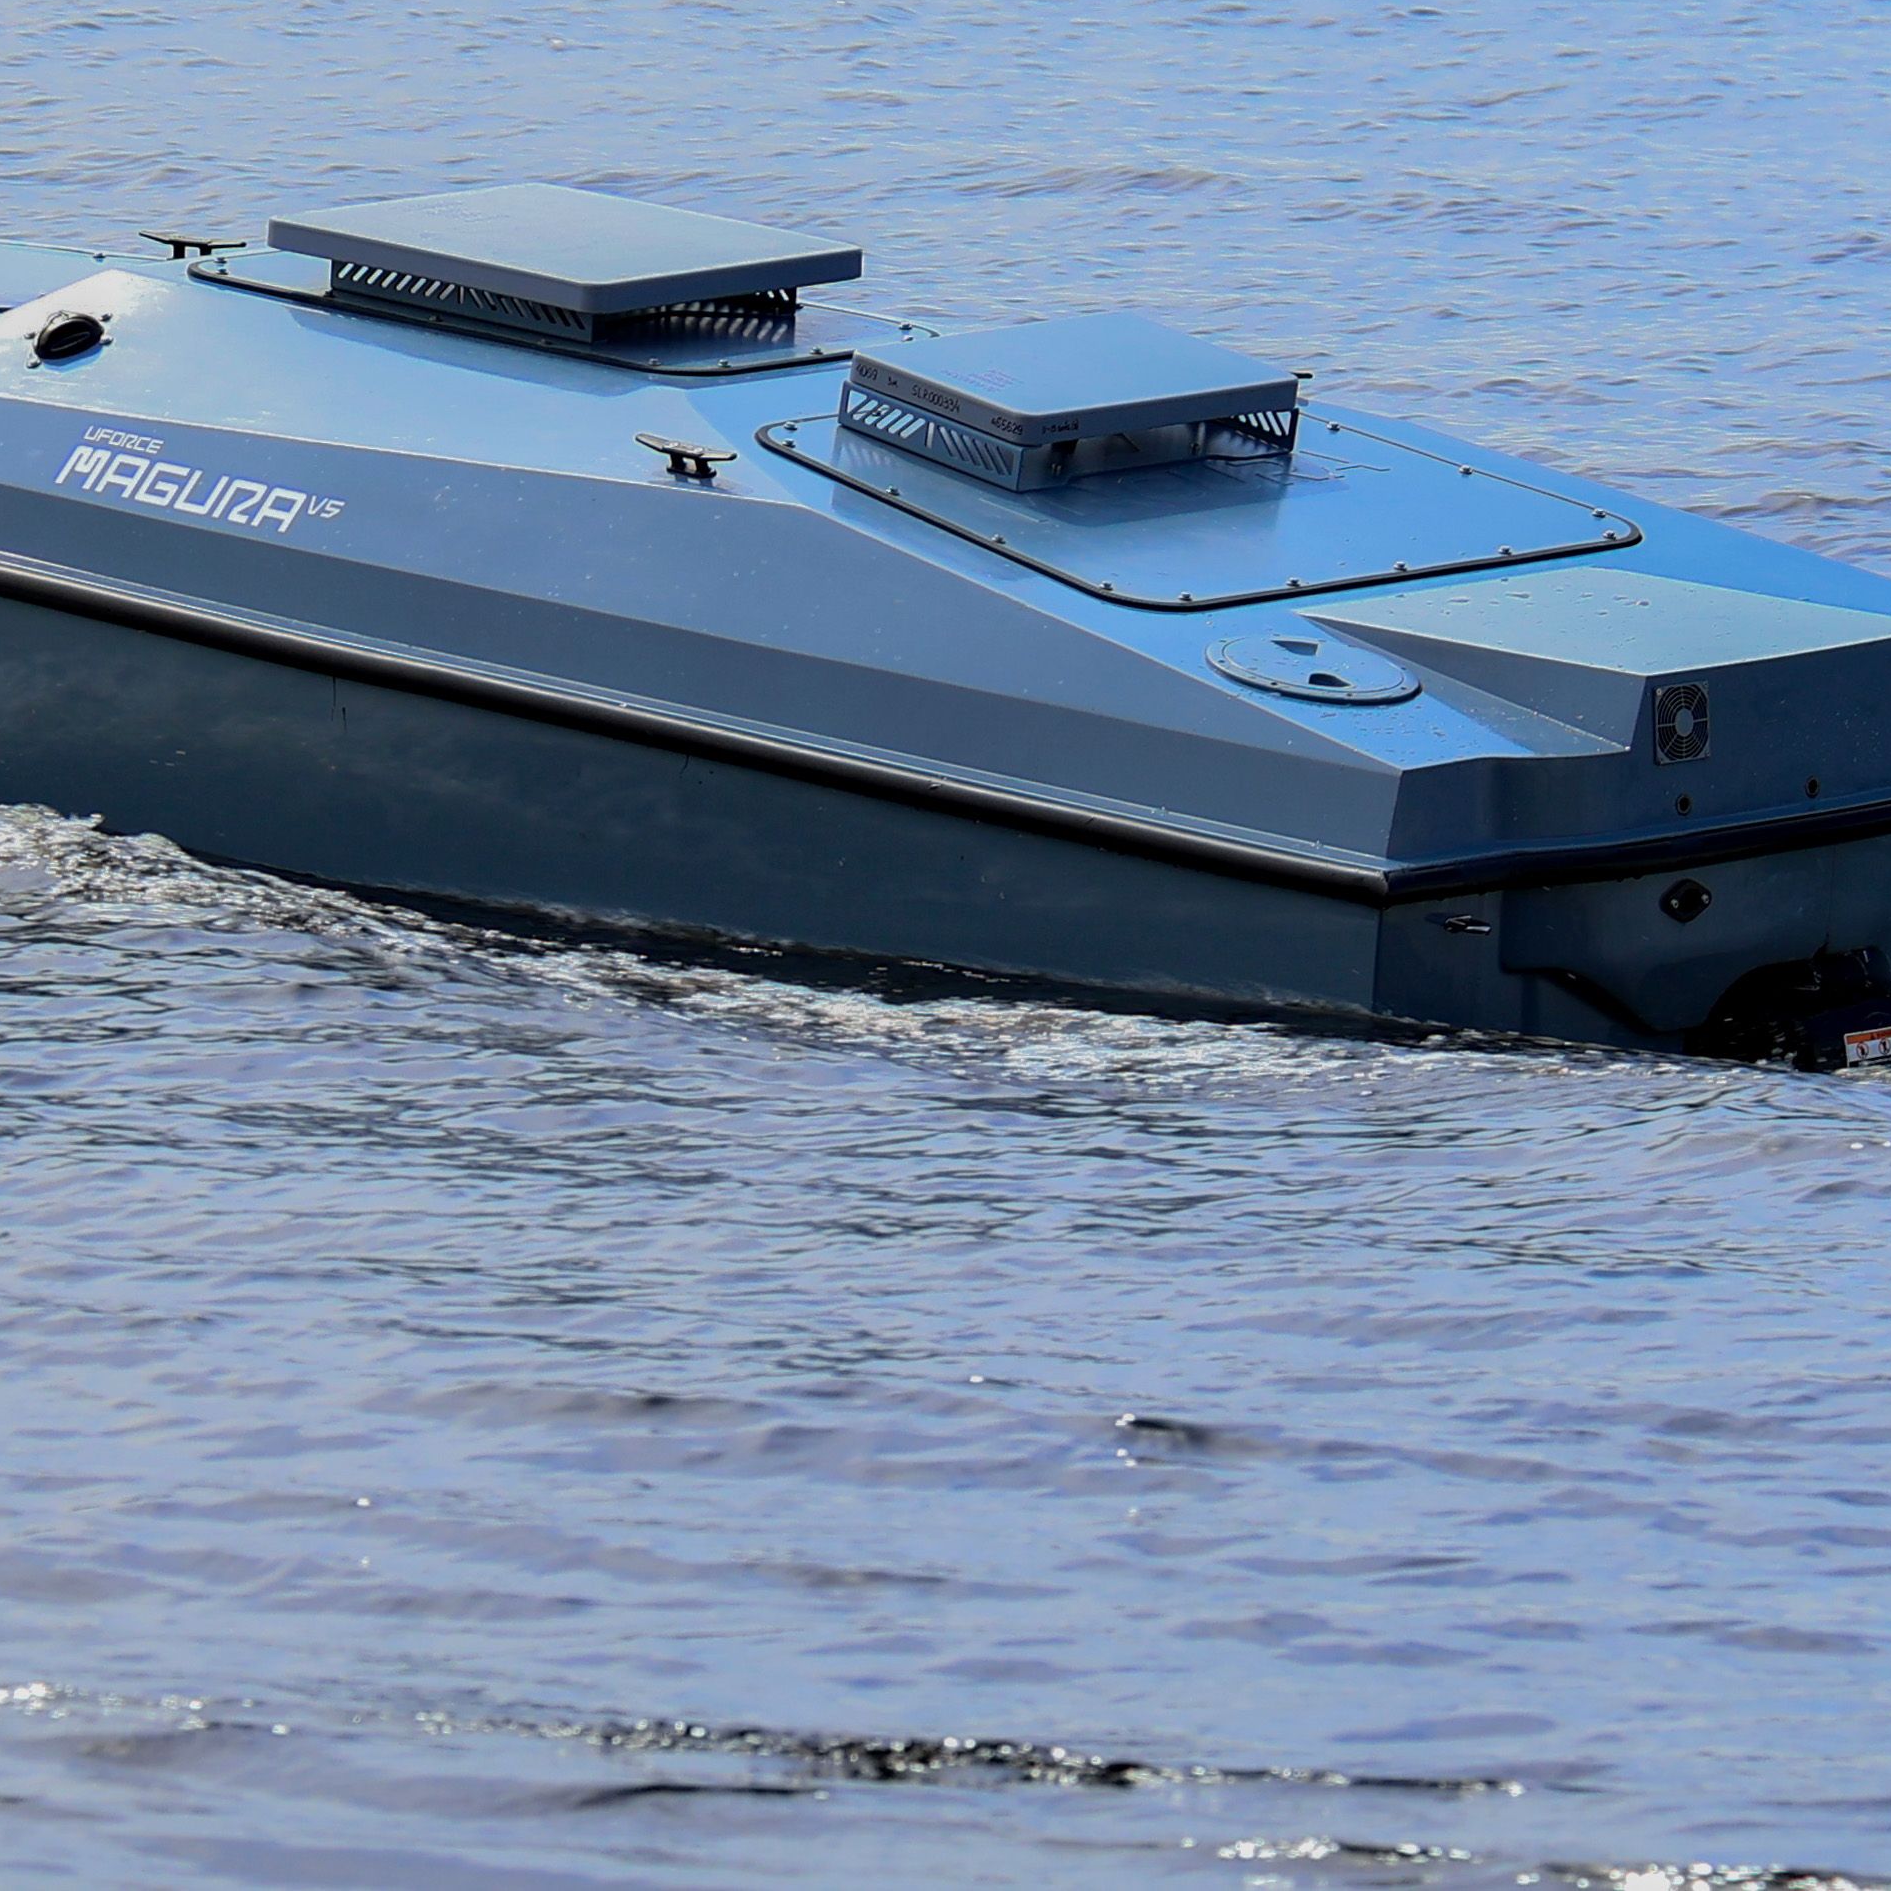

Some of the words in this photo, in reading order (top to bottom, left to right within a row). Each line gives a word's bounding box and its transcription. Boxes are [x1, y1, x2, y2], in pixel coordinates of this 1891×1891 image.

[84, 425, 164, 454] UFORCE
[54, 445, 307, 533] MAGURA
[307, 495, 345, 518] V5
